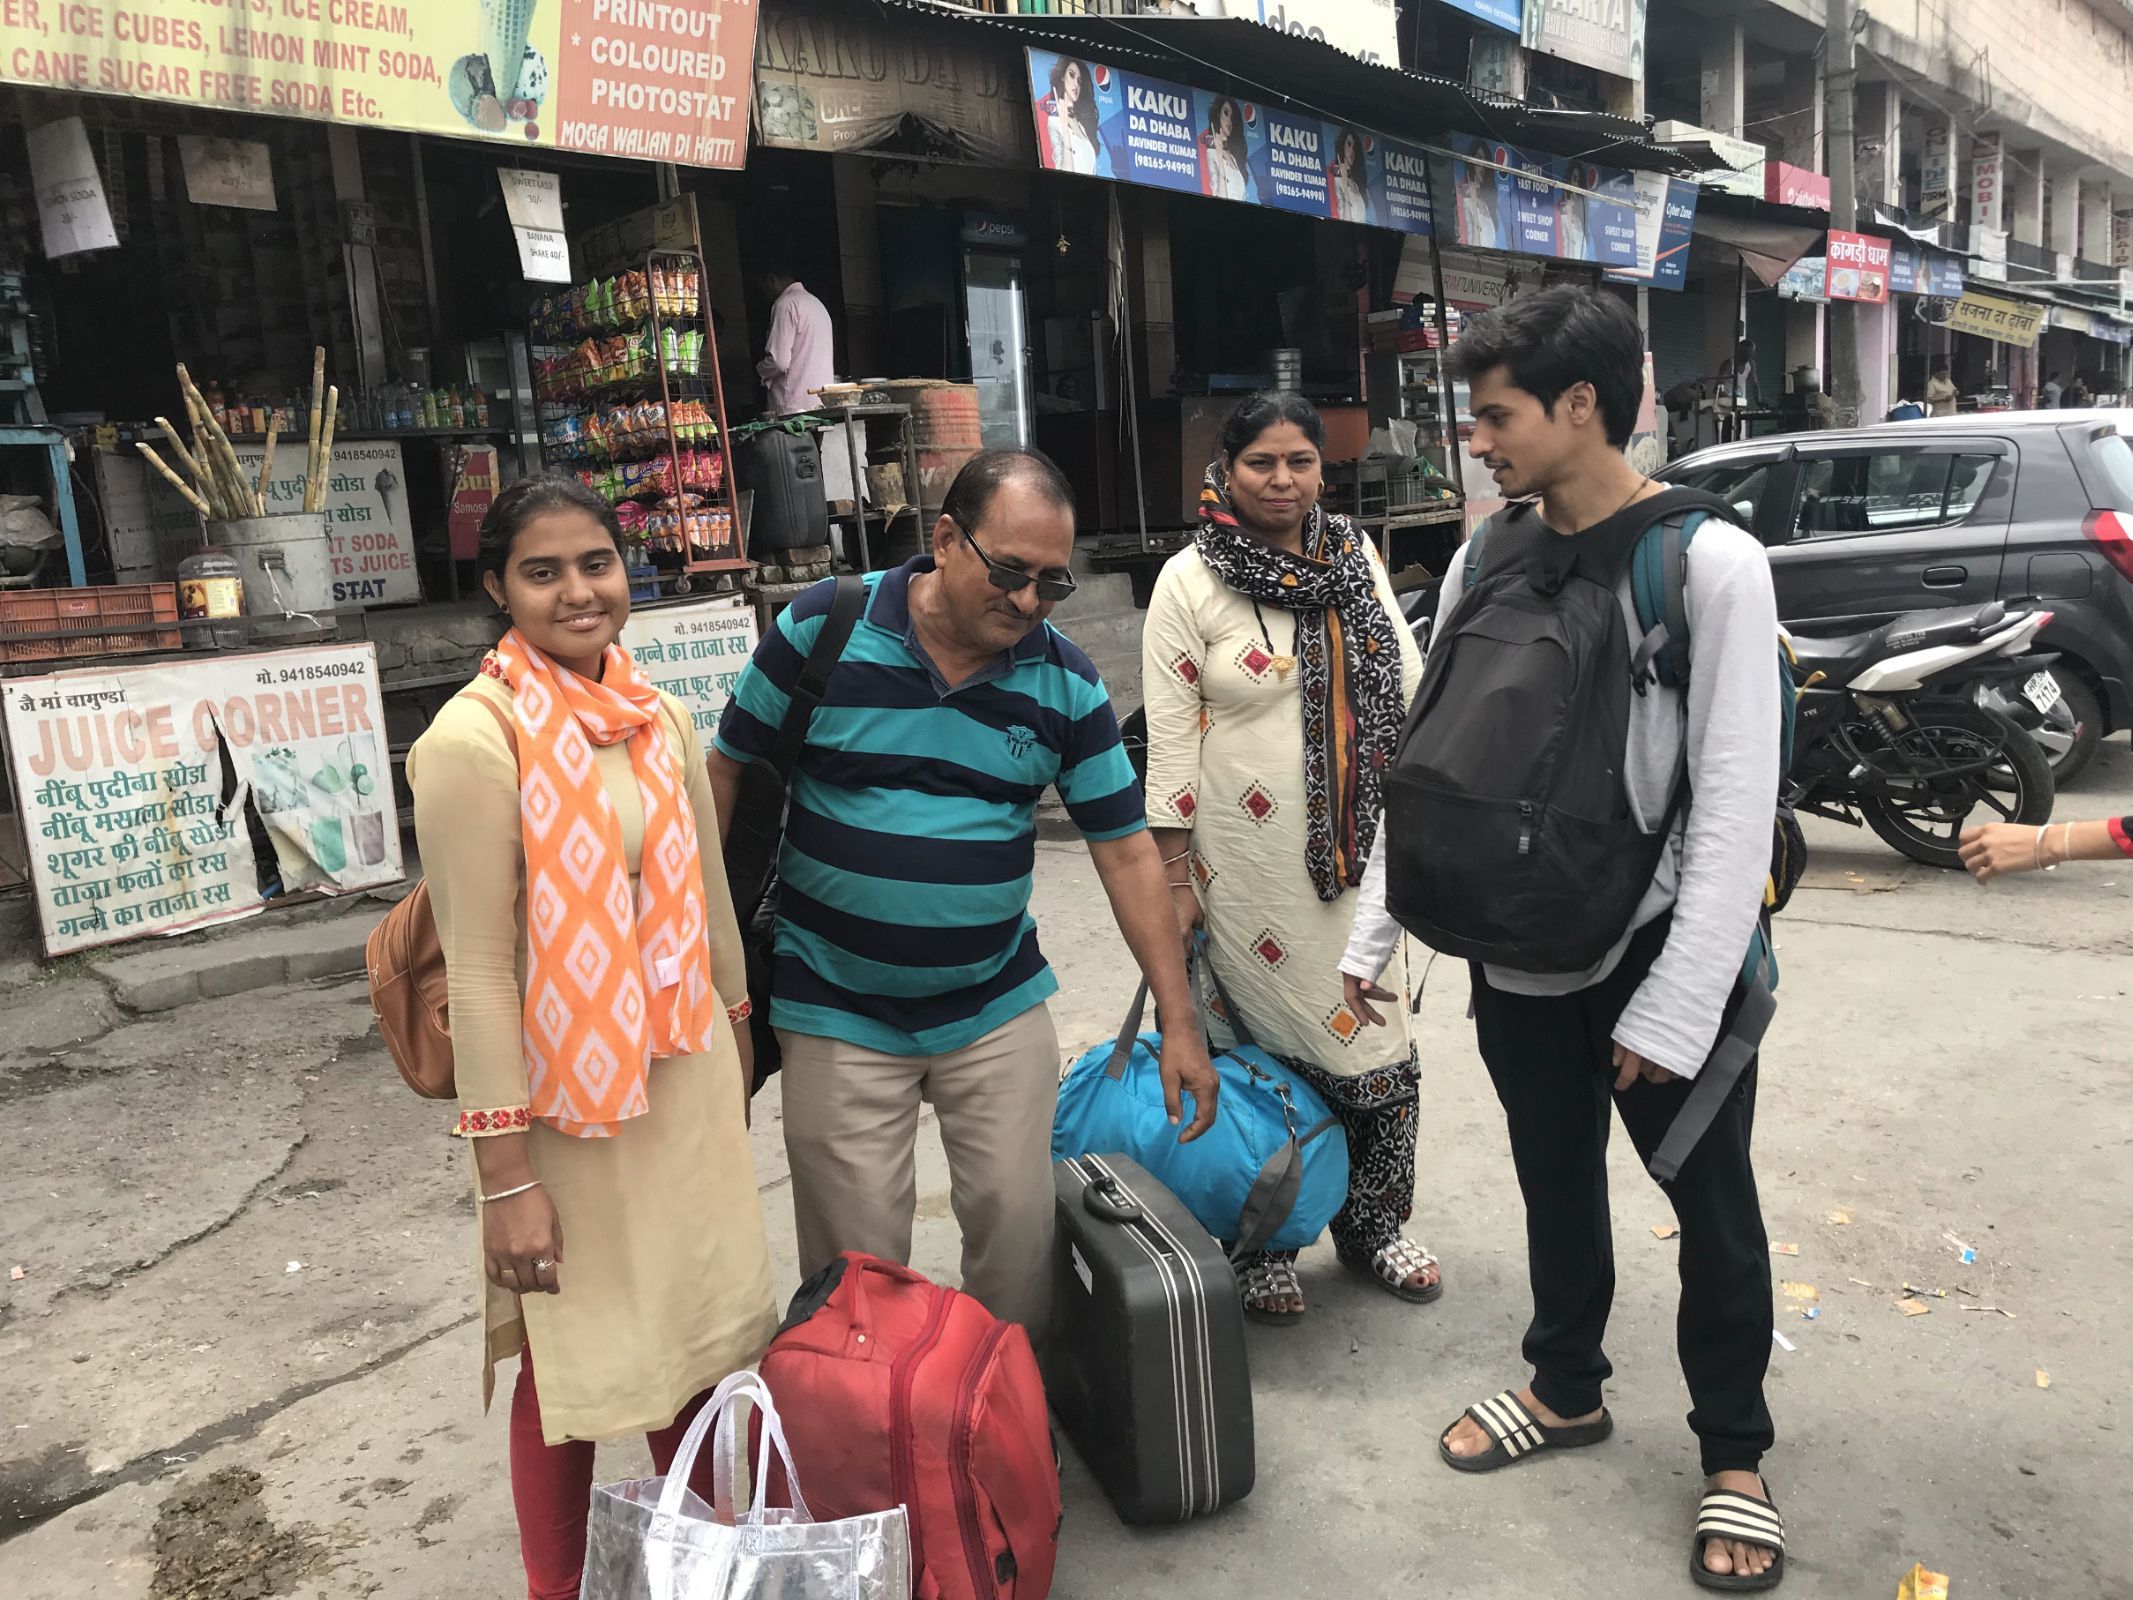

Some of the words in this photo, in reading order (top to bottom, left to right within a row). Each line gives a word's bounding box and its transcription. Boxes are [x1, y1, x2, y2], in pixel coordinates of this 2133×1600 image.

[329, 0, 413, 41] CREAM,
[593, 0, 722, 40] PRINTOUT
[59, 3, 104, 38] ICE
[113, 10, 210, 58] CUBES,
[219, 26, 304, 65] LEMON
[313, 39, 370, 73] MINT
[378, 49, 441, 88] SODA,
[591, 36, 726, 80] COLOURED
[12, 47, 89, 85] CANE
[99, 57, 191, 97] SUGAR
[200, 70, 262, 105] FREE
[271, 79, 334, 113] SODA
[342, 88, 384, 119] Etc.
[591, 78, 736, 121] PHOTOSTAT
[1128, 85, 1187, 120] KAKU
[1129, 114, 1147, 132] DA
[1150, 119, 1191, 141] DHABA
[1269, 122, 1318, 153] KAKU
[560, 120, 609, 151] MOGA
[613, 126, 671, 157] WALIAN
[674, 133, 690, 158] DI
[693, 136, 736, 163] HATTI
[1128, 135, 1168, 153] RAVINDER
[1169, 143, 1197, 159] KUMAR
[1134, 151, 1194, 177] (98165-94998)
[1271, 148, 1286, 163] DA
[1288, 152, 1321, 171] DHABA
[1385, 152, 1424, 177] KAKU
[512, 178, 536, 187] SWEET
[1271, 166, 1303, 183] RAVINDER
[1303, 173, 1326, 187] KUMAR
[1386, 174, 1398, 188] DA
[1400, 177, 1427, 194] DHABA
[1532, 181, 1549, 193] FOOD
[1517, 211, 1536, 224] SWEET
[1537, 214, 1553, 226] SHOP
[1666, 202, 1680, 218] Cyber
[1680, 205, 1692, 219] Zone
[527, 232, 554, 242] BANANA
[988, 222, 1014, 235] pepsi
[1525, 229, 1549, 242] CORNER
[1605, 225, 1620, 237] SWEET
[530, 248, 549, 258] SHAKE
[1611, 241, 1631, 253] CORNER
[333, 449, 397, 461] 9418540942
[330, 473, 367, 492] सोडा
[336, 503, 372, 523] सोडा
[454, 502, 488, 513] Samosa
[351, 533, 399, 552] SODA
[359, 552, 411, 573] JUICE
[332, 578, 386, 601] STAT
[690, 617, 750, 634] 9418540942
[667, 641, 689, 662] का
[690, 638, 725, 659] ताजा
[728, 635, 748, 654] रस
[256, 668, 277, 685] मो.
[279, 661, 365, 683] 9418540942
[2028, 680, 2038, 693] HP
[2035, 680, 2058, 709] 7174
[18, 694, 37, 712] जै
[40, 692, 62, 709] मां
[65, 689, 126, 711] चामुण्डा
[28, 704, 180, 776] JUICE
[193, 683, 373, 752] CORNER
[34, 779, 92, 812] नींबू
[88, 771, 157, 808] पुदीना
[162, 761, 207, 790] सोडा
[40, 812, 97, 844] नींबू
[93, 802, 167, 832] मसाला
[171, 791, 215, 817] सोडा
[47, 847, 106, 880] शूगर
[143, 827, 192, 856] नींबू
[187, 819, 236, 846] सोडा
[51, 879, 111, 907] ताजा
[116, 859, 164, 893] फलों
[166, 860, 195, 882] का
[197, 852, 229, 874] रस
[112, 904, 143, 926] का
[146, 890, 199, 918] ताजा
[201, 882, 232, 904] रस
